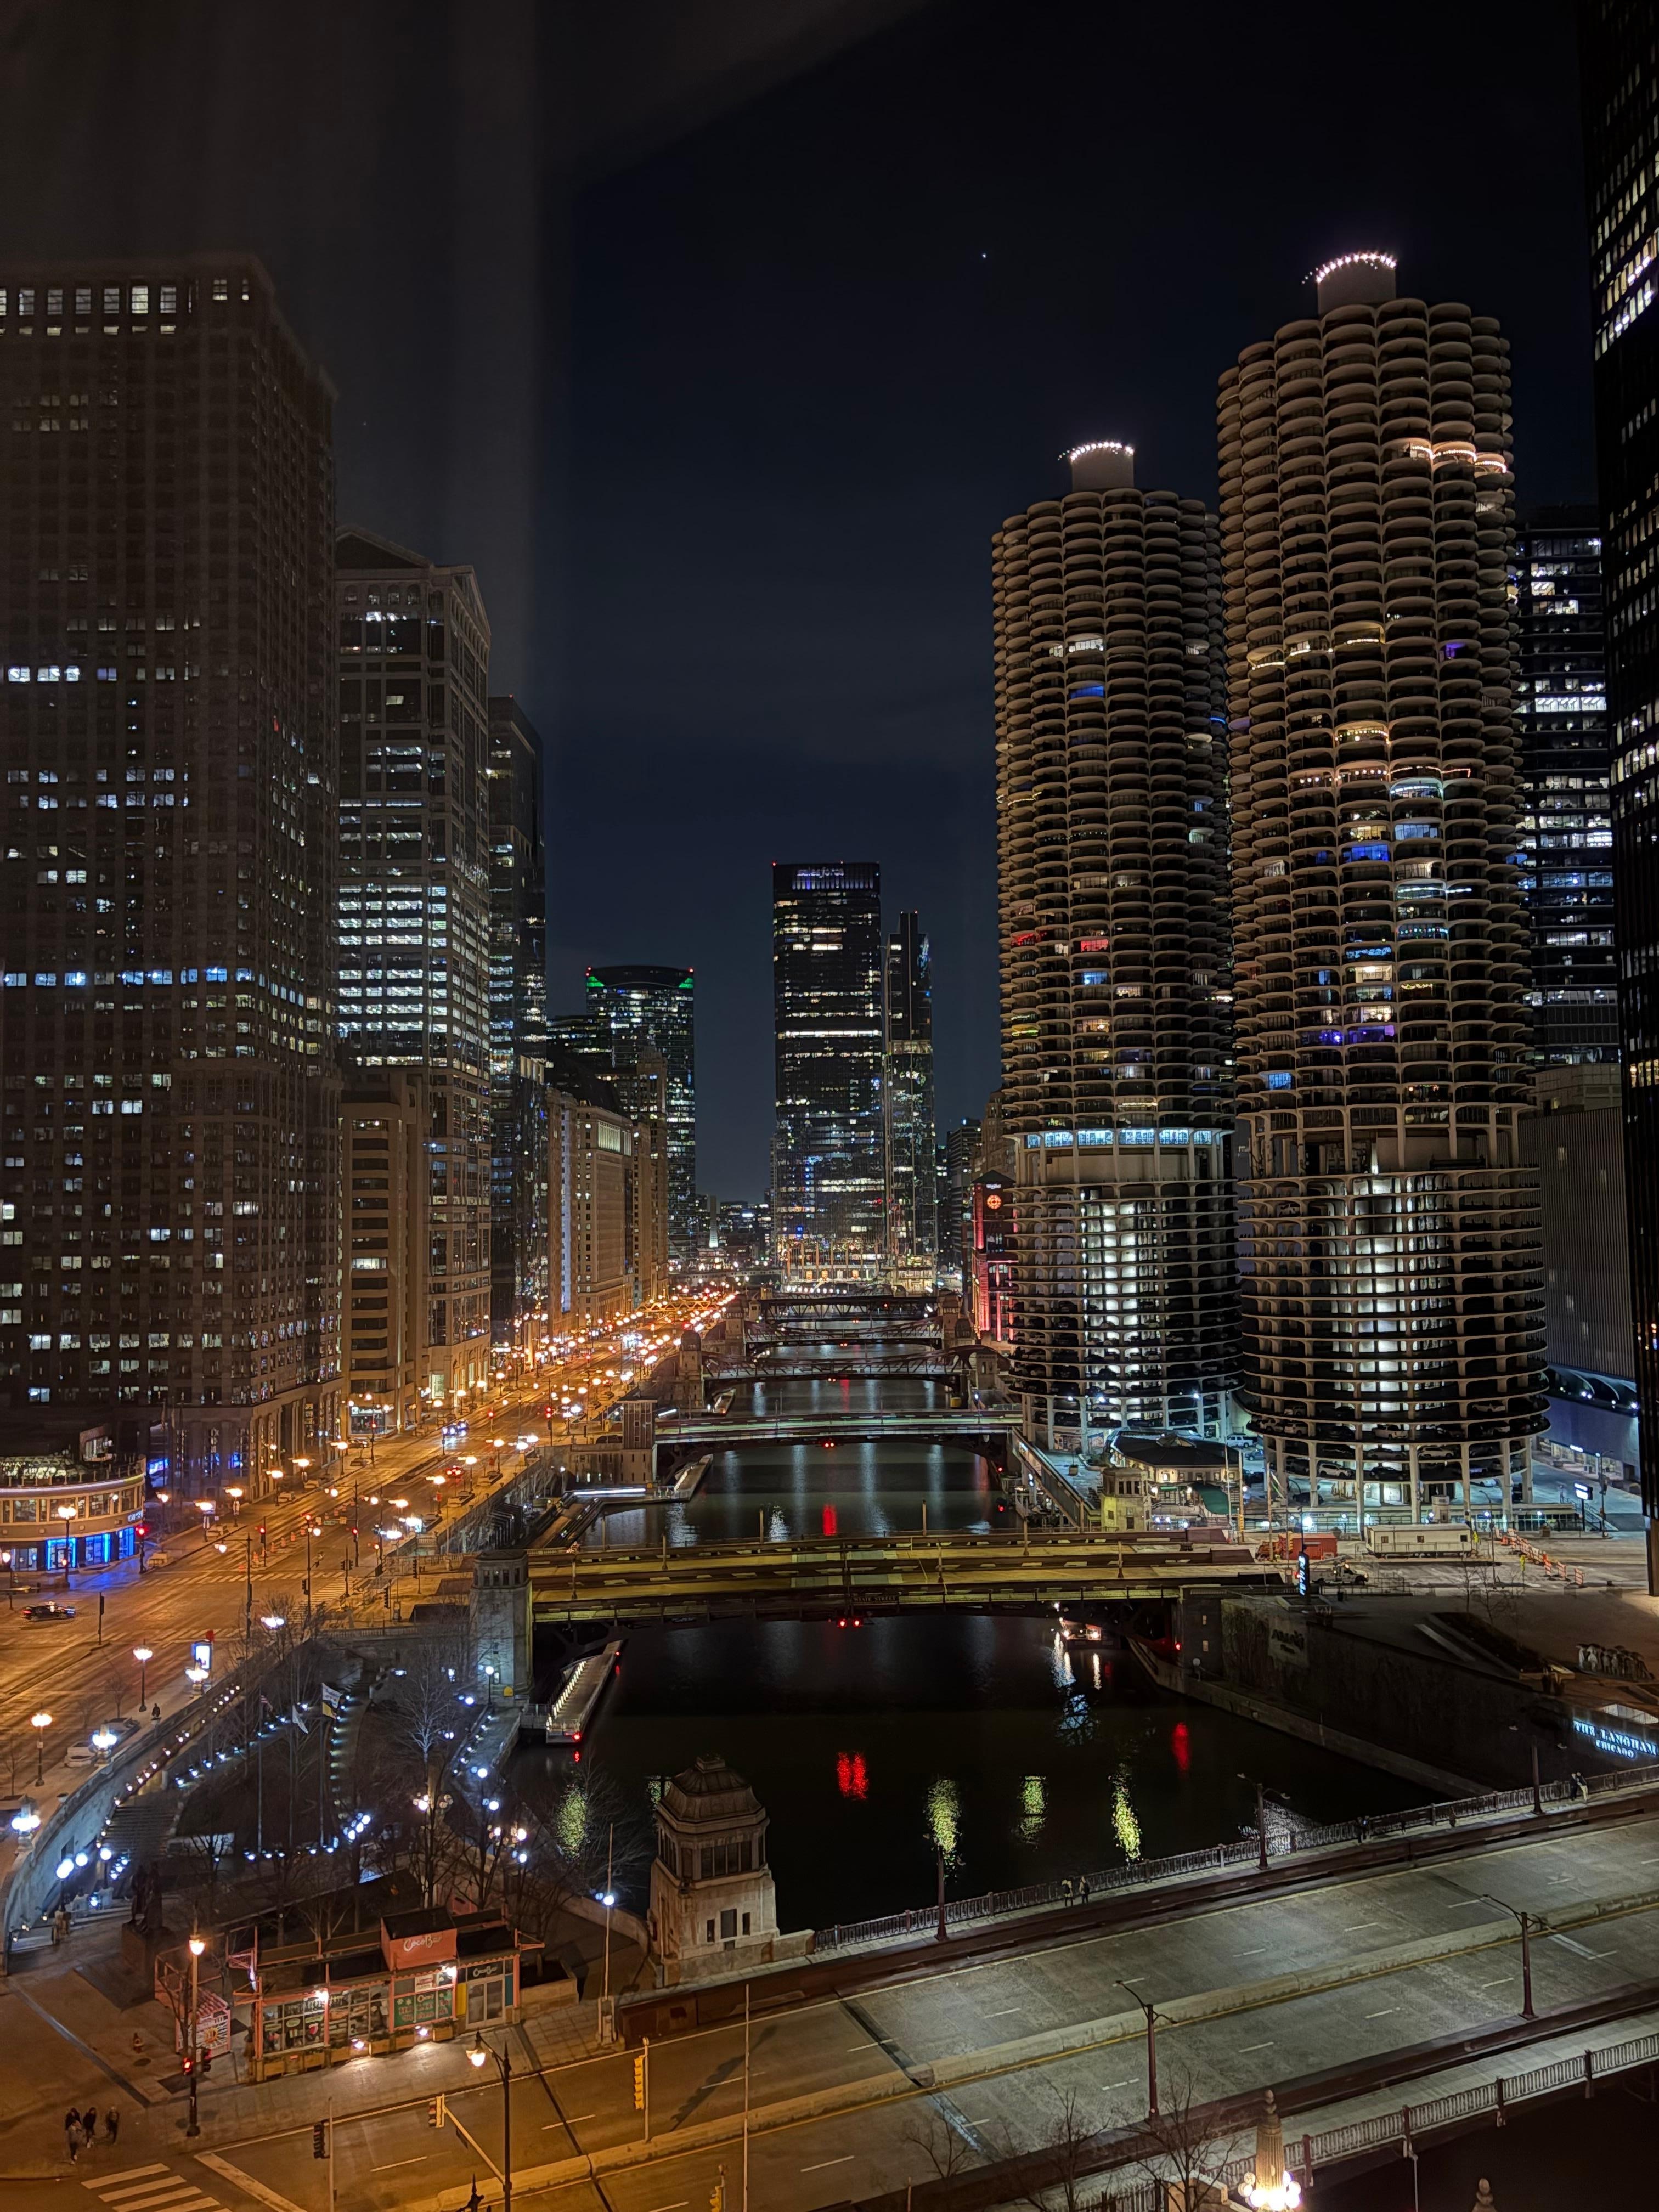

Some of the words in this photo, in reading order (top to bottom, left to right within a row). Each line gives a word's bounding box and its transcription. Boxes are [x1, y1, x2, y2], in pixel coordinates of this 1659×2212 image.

[1573, 1720, 1595, 1736] THE
[1600, 1729, 1657, 1756] LANGHAM
[1595, 1739, 1634, 1758] CHICAGO
